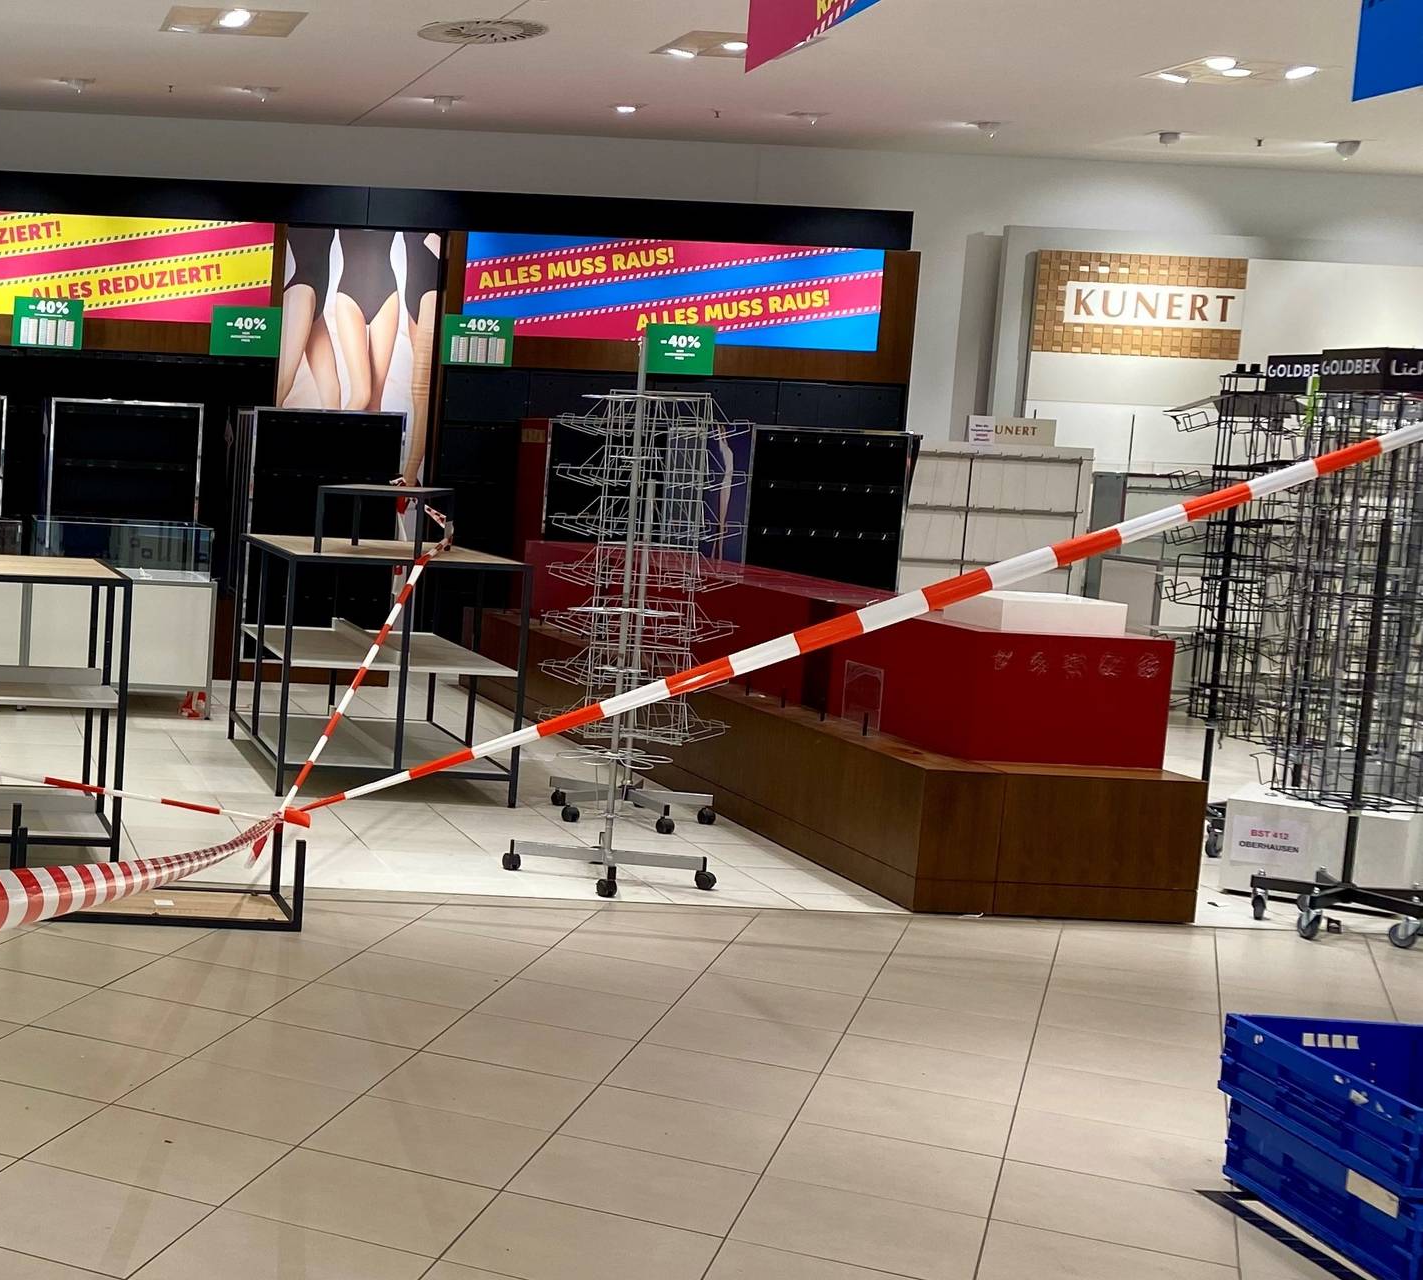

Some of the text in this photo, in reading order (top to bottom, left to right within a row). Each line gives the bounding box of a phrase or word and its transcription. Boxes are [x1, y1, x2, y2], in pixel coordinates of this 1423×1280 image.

[478, 246, 675, 290] ALLES MUSS RAUS!
[98, 263, 222, 297] REDUZIERT!
[28, 300, 70, 315] -40%
[704, 300, 764, 323] MUSS
[768, 289, 830, 314] RAUS!
[1073, 288, 1236, 323] KUNERT
[226, 316, 267, 331] -40%
[459, 318, 500, 332] -40%
[660, 334, 702, 349] -40%
[1268, 363, 1320, 378] GOLDBE
[1320, 358, 1381, 375] GOLDBEK
[995, 425, 1038, 436] UNERT
[1250, 829, 1272, 838] BST
[1238, 840, 1299, 853] OBERHAUSEN
